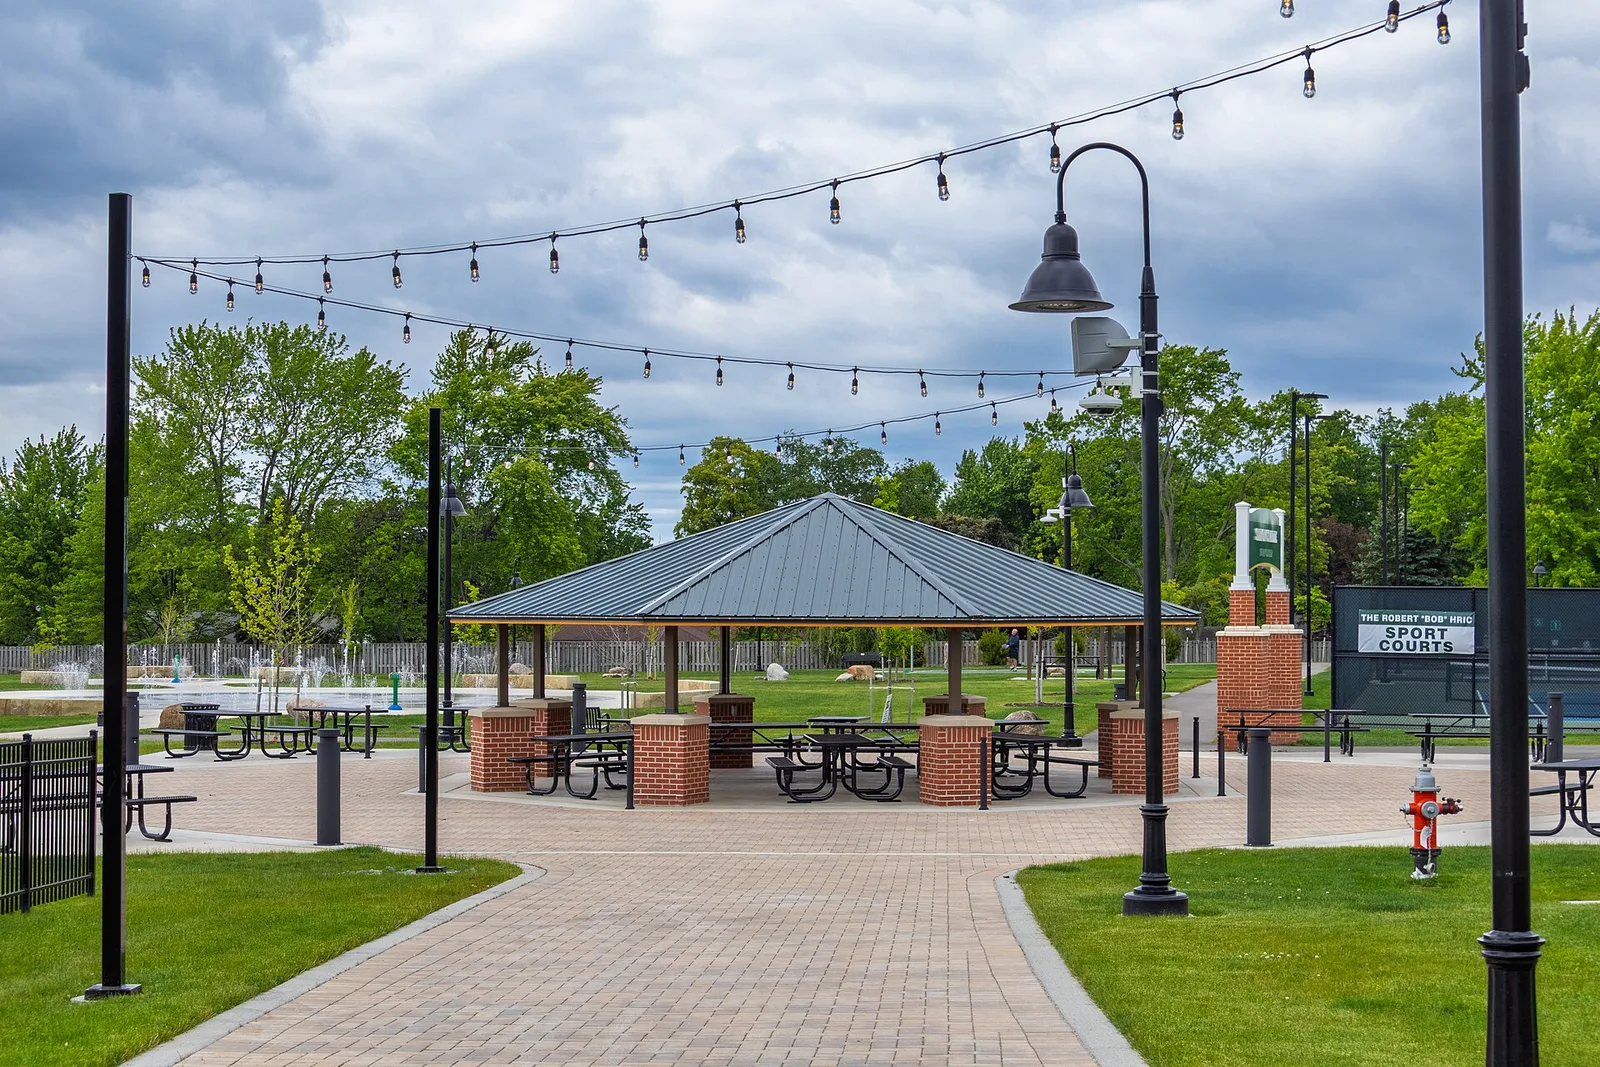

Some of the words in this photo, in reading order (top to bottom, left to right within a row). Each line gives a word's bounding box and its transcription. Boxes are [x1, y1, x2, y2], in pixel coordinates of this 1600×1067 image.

[1361, 614, 1379, 622] THE
[1382, 614, 1419, 622] ROBERT
[1421, 615, 1448, 623] "BOB"
[1450, 616, 1473, 624] HRIC
[1385, 627, 1448, 640] SPORT
[1379, 640, 1453, 652] COURTS
